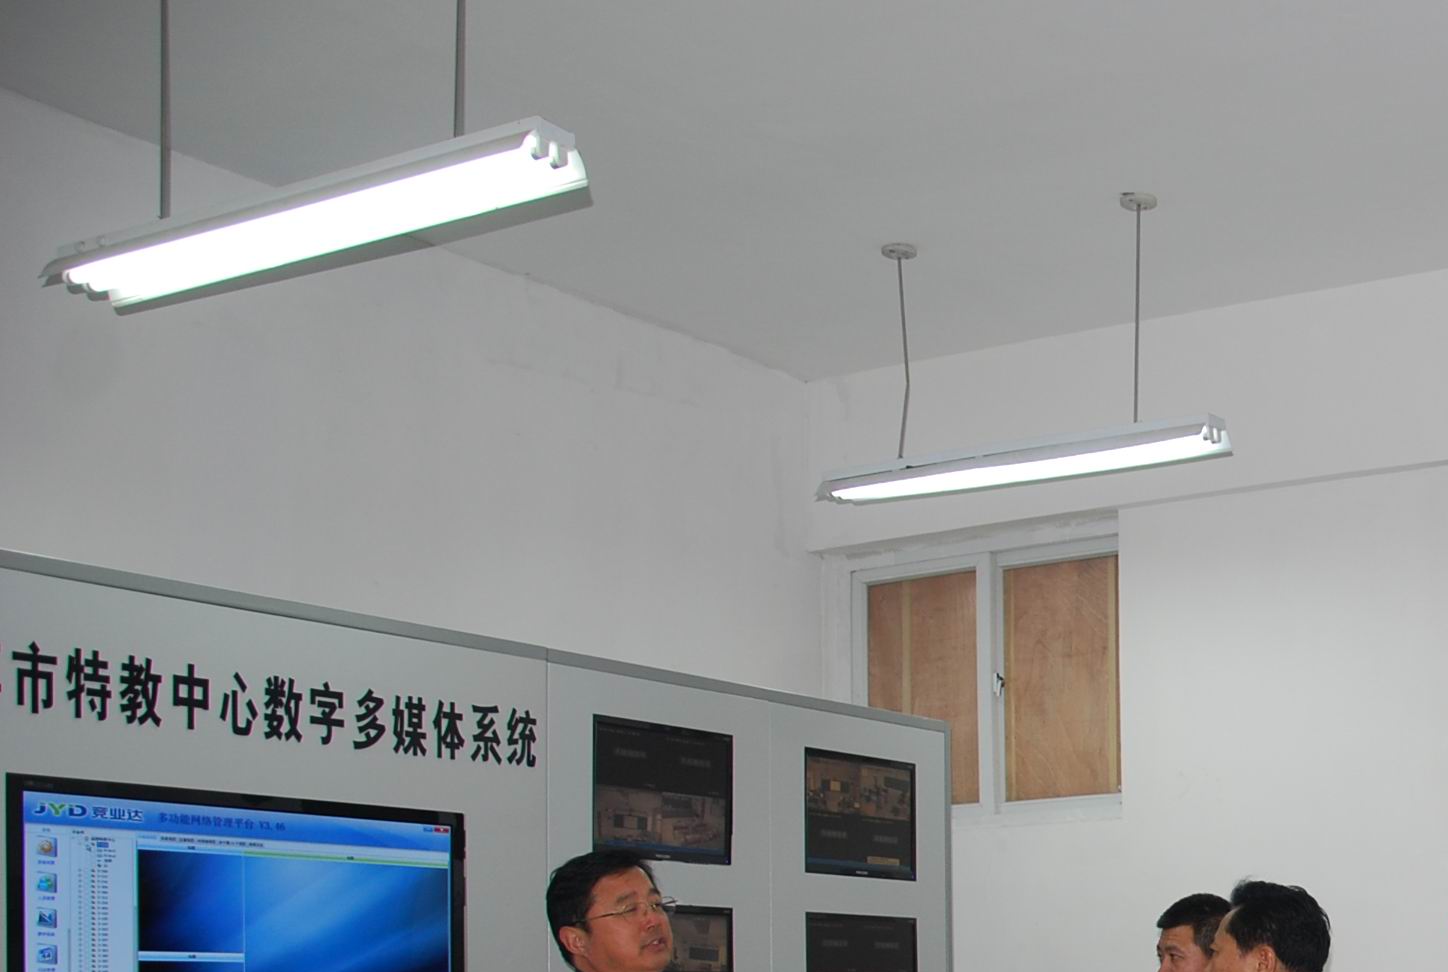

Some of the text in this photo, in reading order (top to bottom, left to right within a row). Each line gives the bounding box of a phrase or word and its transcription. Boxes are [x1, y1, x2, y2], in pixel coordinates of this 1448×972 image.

[0, 640, 537, 768] 市特教中心数字多媒体系统
[33, 801, 144, 823] JYD 竞业达
